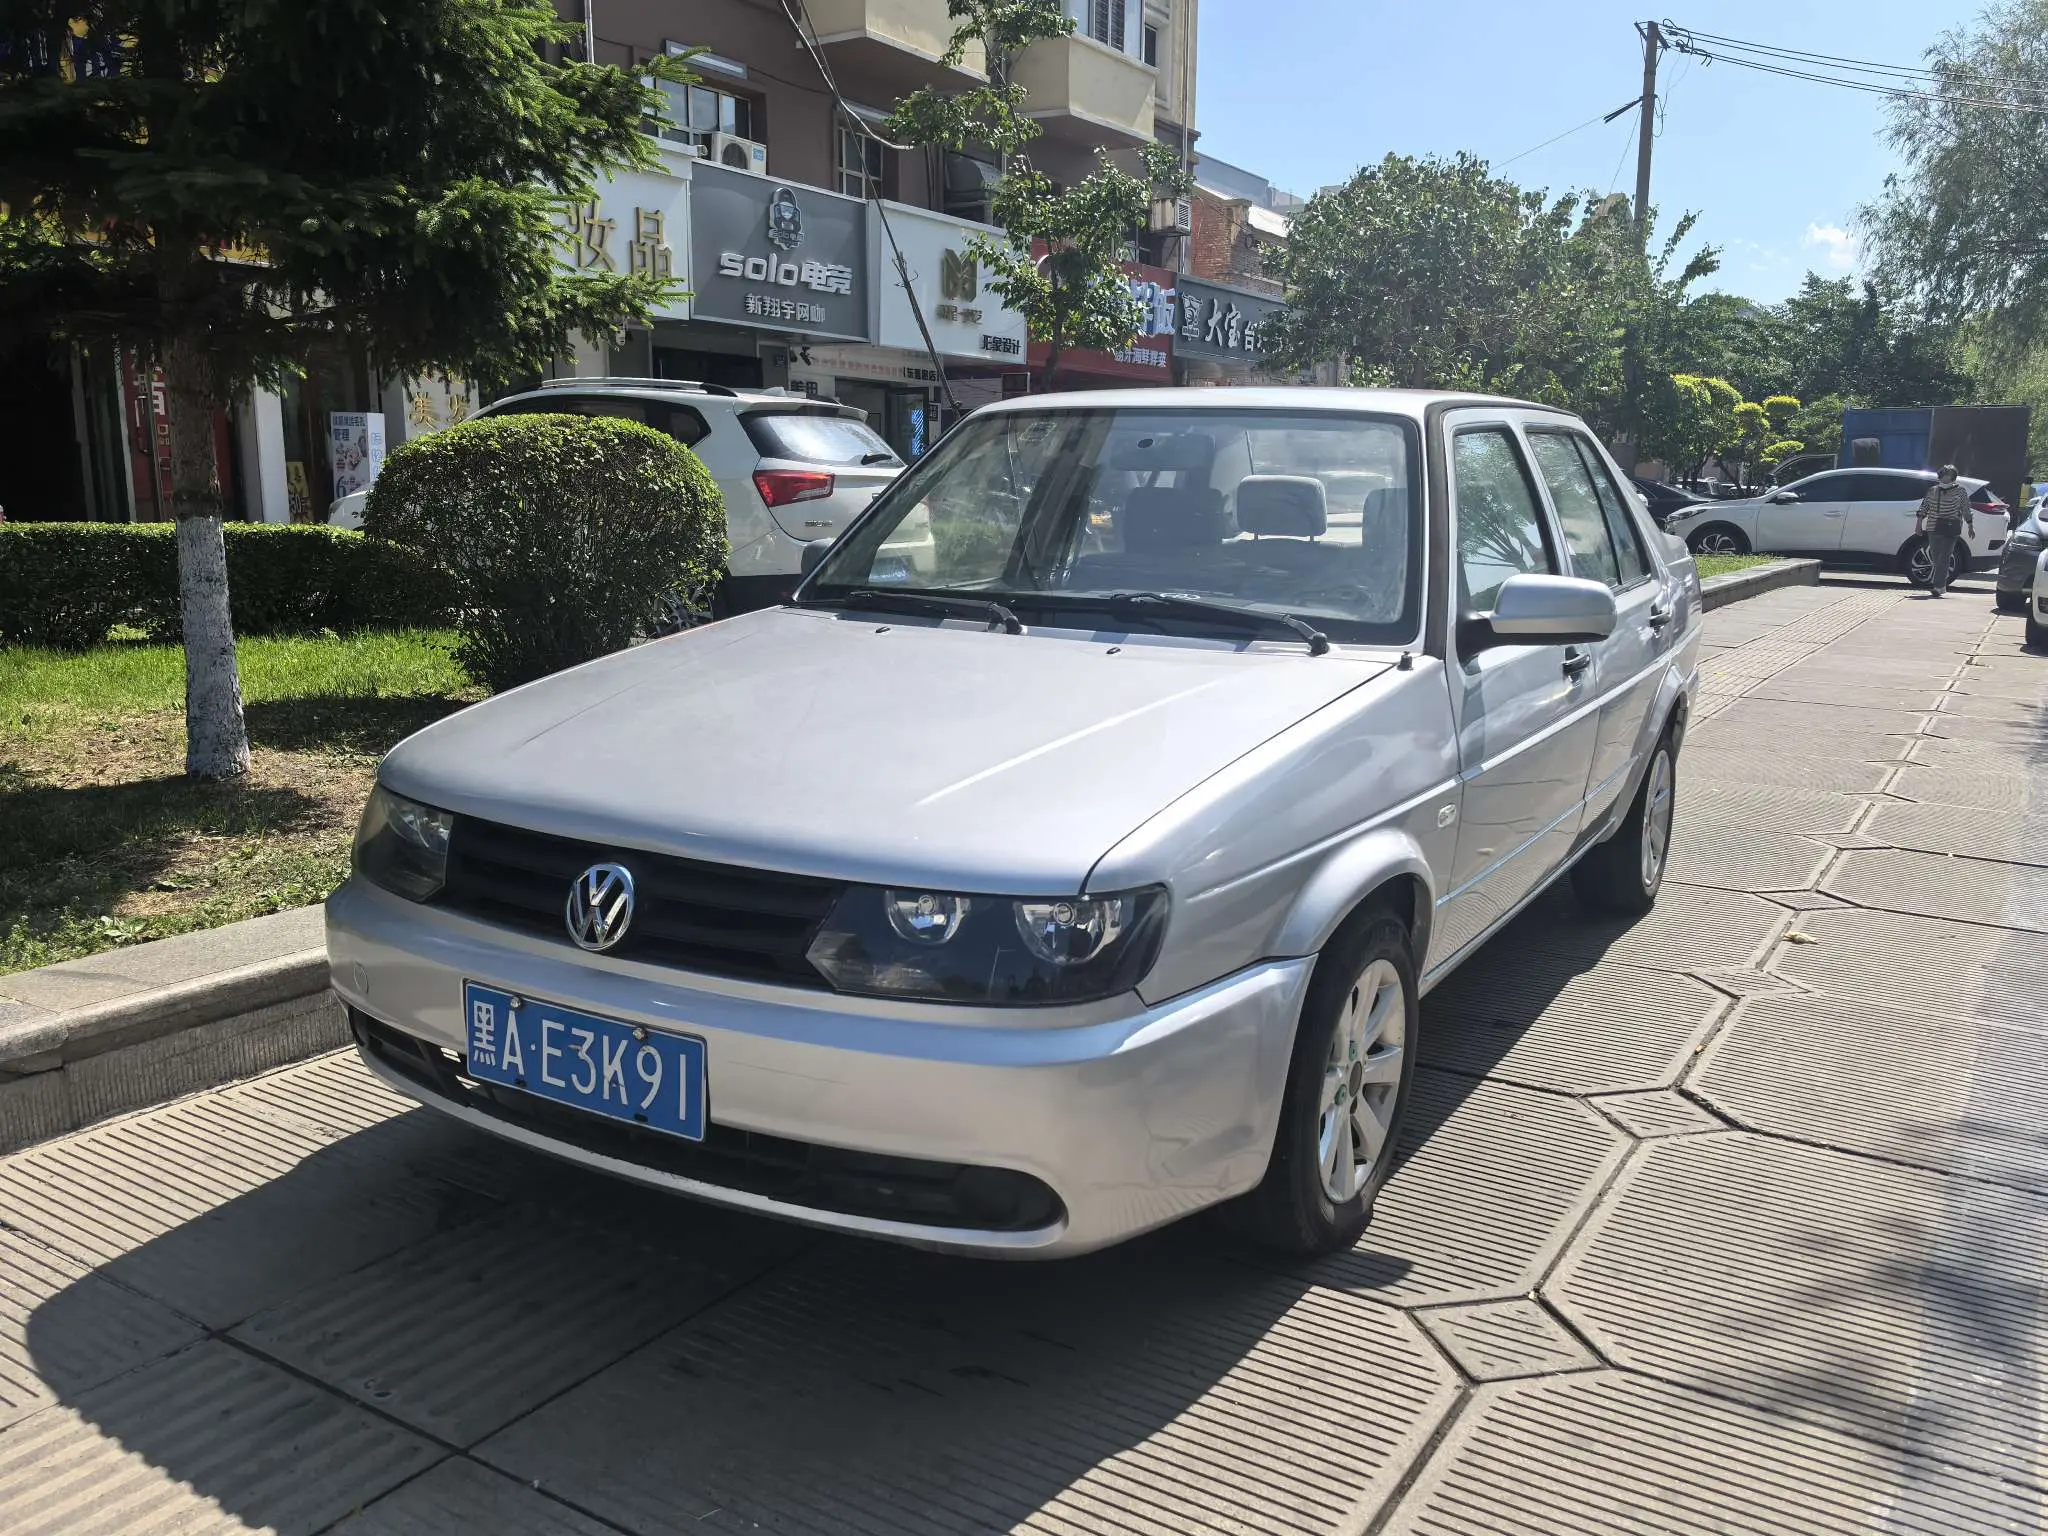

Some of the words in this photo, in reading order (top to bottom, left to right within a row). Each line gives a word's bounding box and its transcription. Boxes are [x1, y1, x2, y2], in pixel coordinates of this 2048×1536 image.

[565, 199, 672, 280] 妆品
[745, 293, 826, 323] 新翔宇网咖
